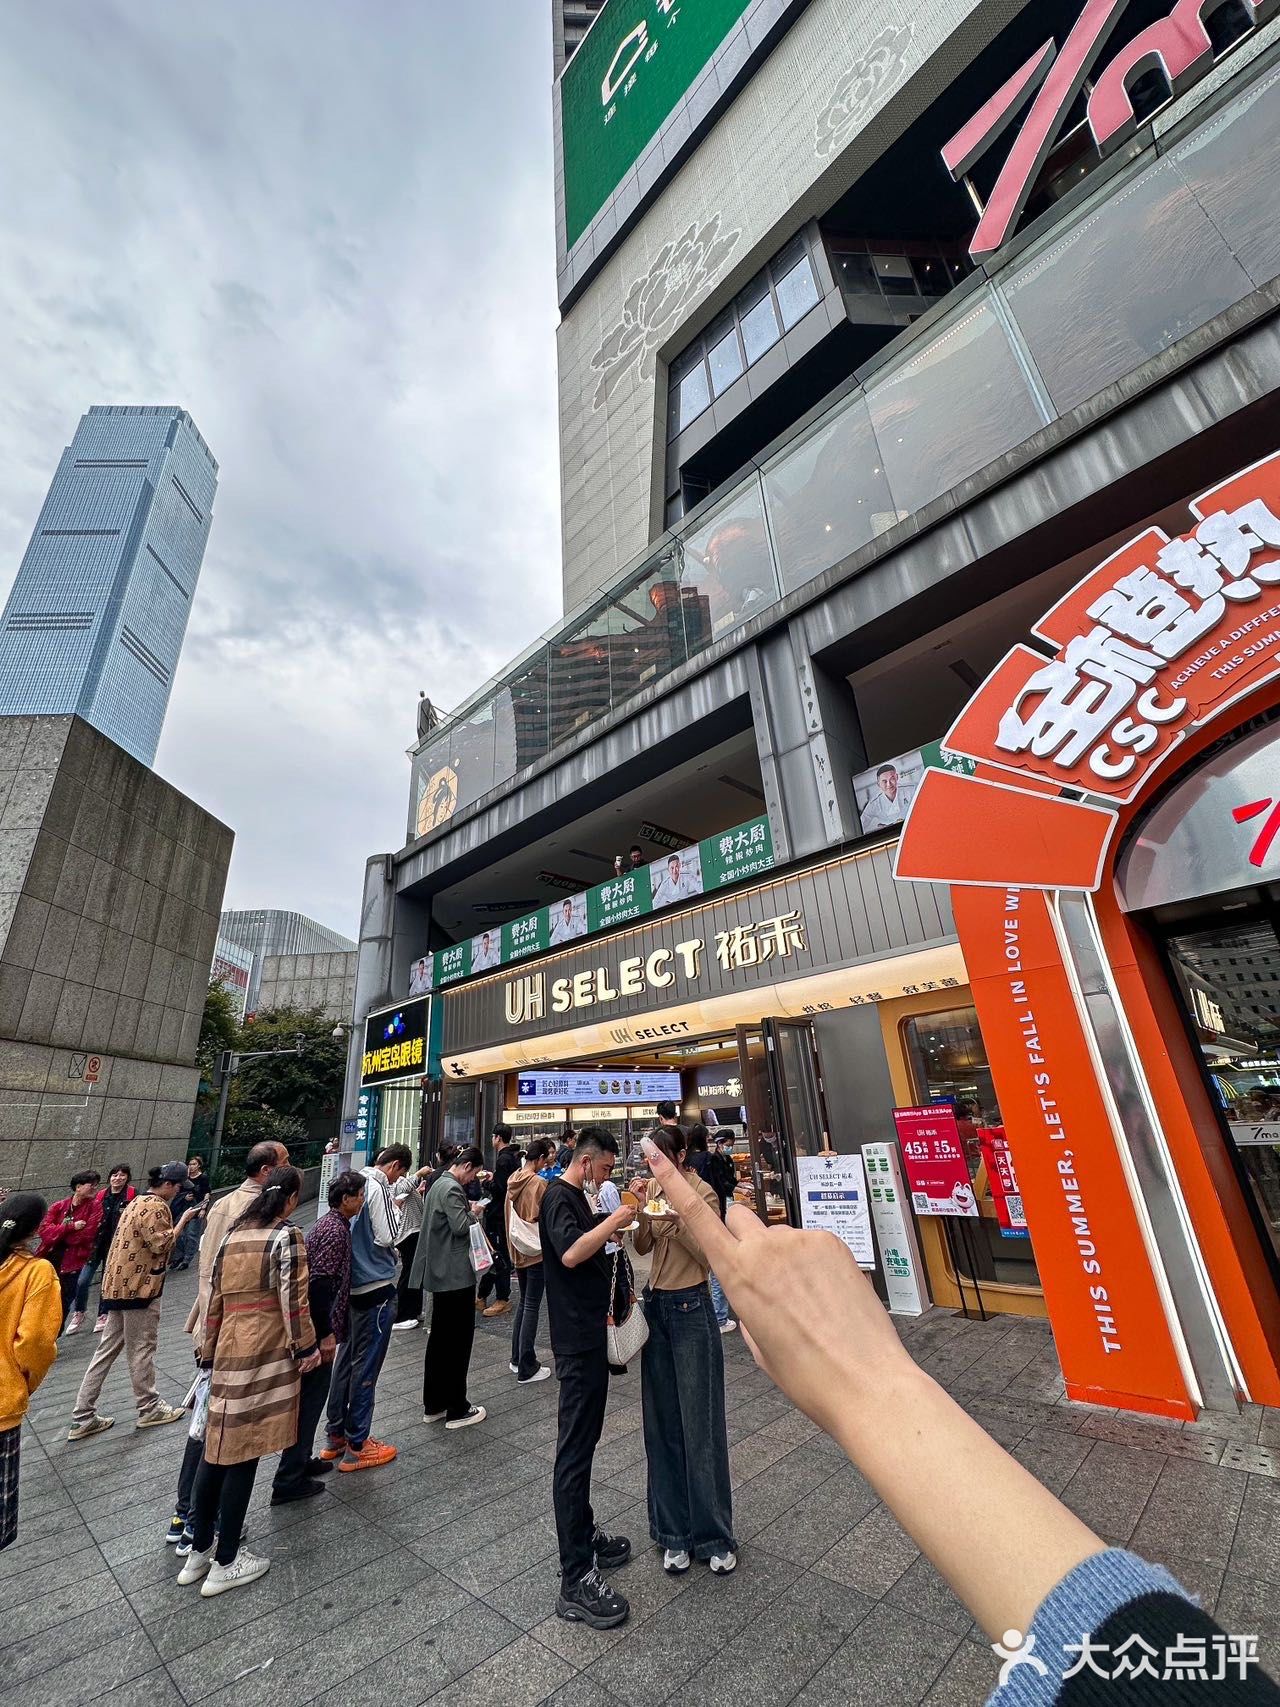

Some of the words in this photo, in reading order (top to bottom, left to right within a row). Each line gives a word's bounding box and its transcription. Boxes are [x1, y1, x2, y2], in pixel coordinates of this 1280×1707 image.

[1170, 646, 1221, 690] ACHIEVE
[1219, 639, 1232, 649] A
[1229, 603, 1280, 642] DIFFFE
[1210, 655, 1244, 679] THIS
[1089, 686, 1187, 780] CSC
[719, 824, 766, 857] 费大厨
[725, 843, 764, 865] 辣椒炒肉
[719, 855, 776, 883] 全国小炒肉大王
[600, 877, 635, 904] 费大厨
[511, 916, 538, 939] 费大厨
[599, 905, 641, 927] 全国小炒肉大王
[442, 947, 464, 967] 费大厨
[1004, 919, 1022, 973] LOVE
[505, 972, 547, 1024] UH
[551, 938, 705, 1014] SELECT
[714, 909, 807, 972] 祐禾
[1010, 980, 1028, 1003] IN
[609, 1027, 632, 1045] UH
[635, 1021, 691, 1041] SELECT
[1019, 1010, 1045, 1064] FALL
[362, 1037, 424, 1078] 杭州宝岛眼镜
[356, 1094, 370, 1141] 专业验光
[1034, 1072, 1066, 1140] LET'S
[1057, 1149, 1102, 1275] SUMMER,
[1089, 1284, 1122, 1355] THIS
